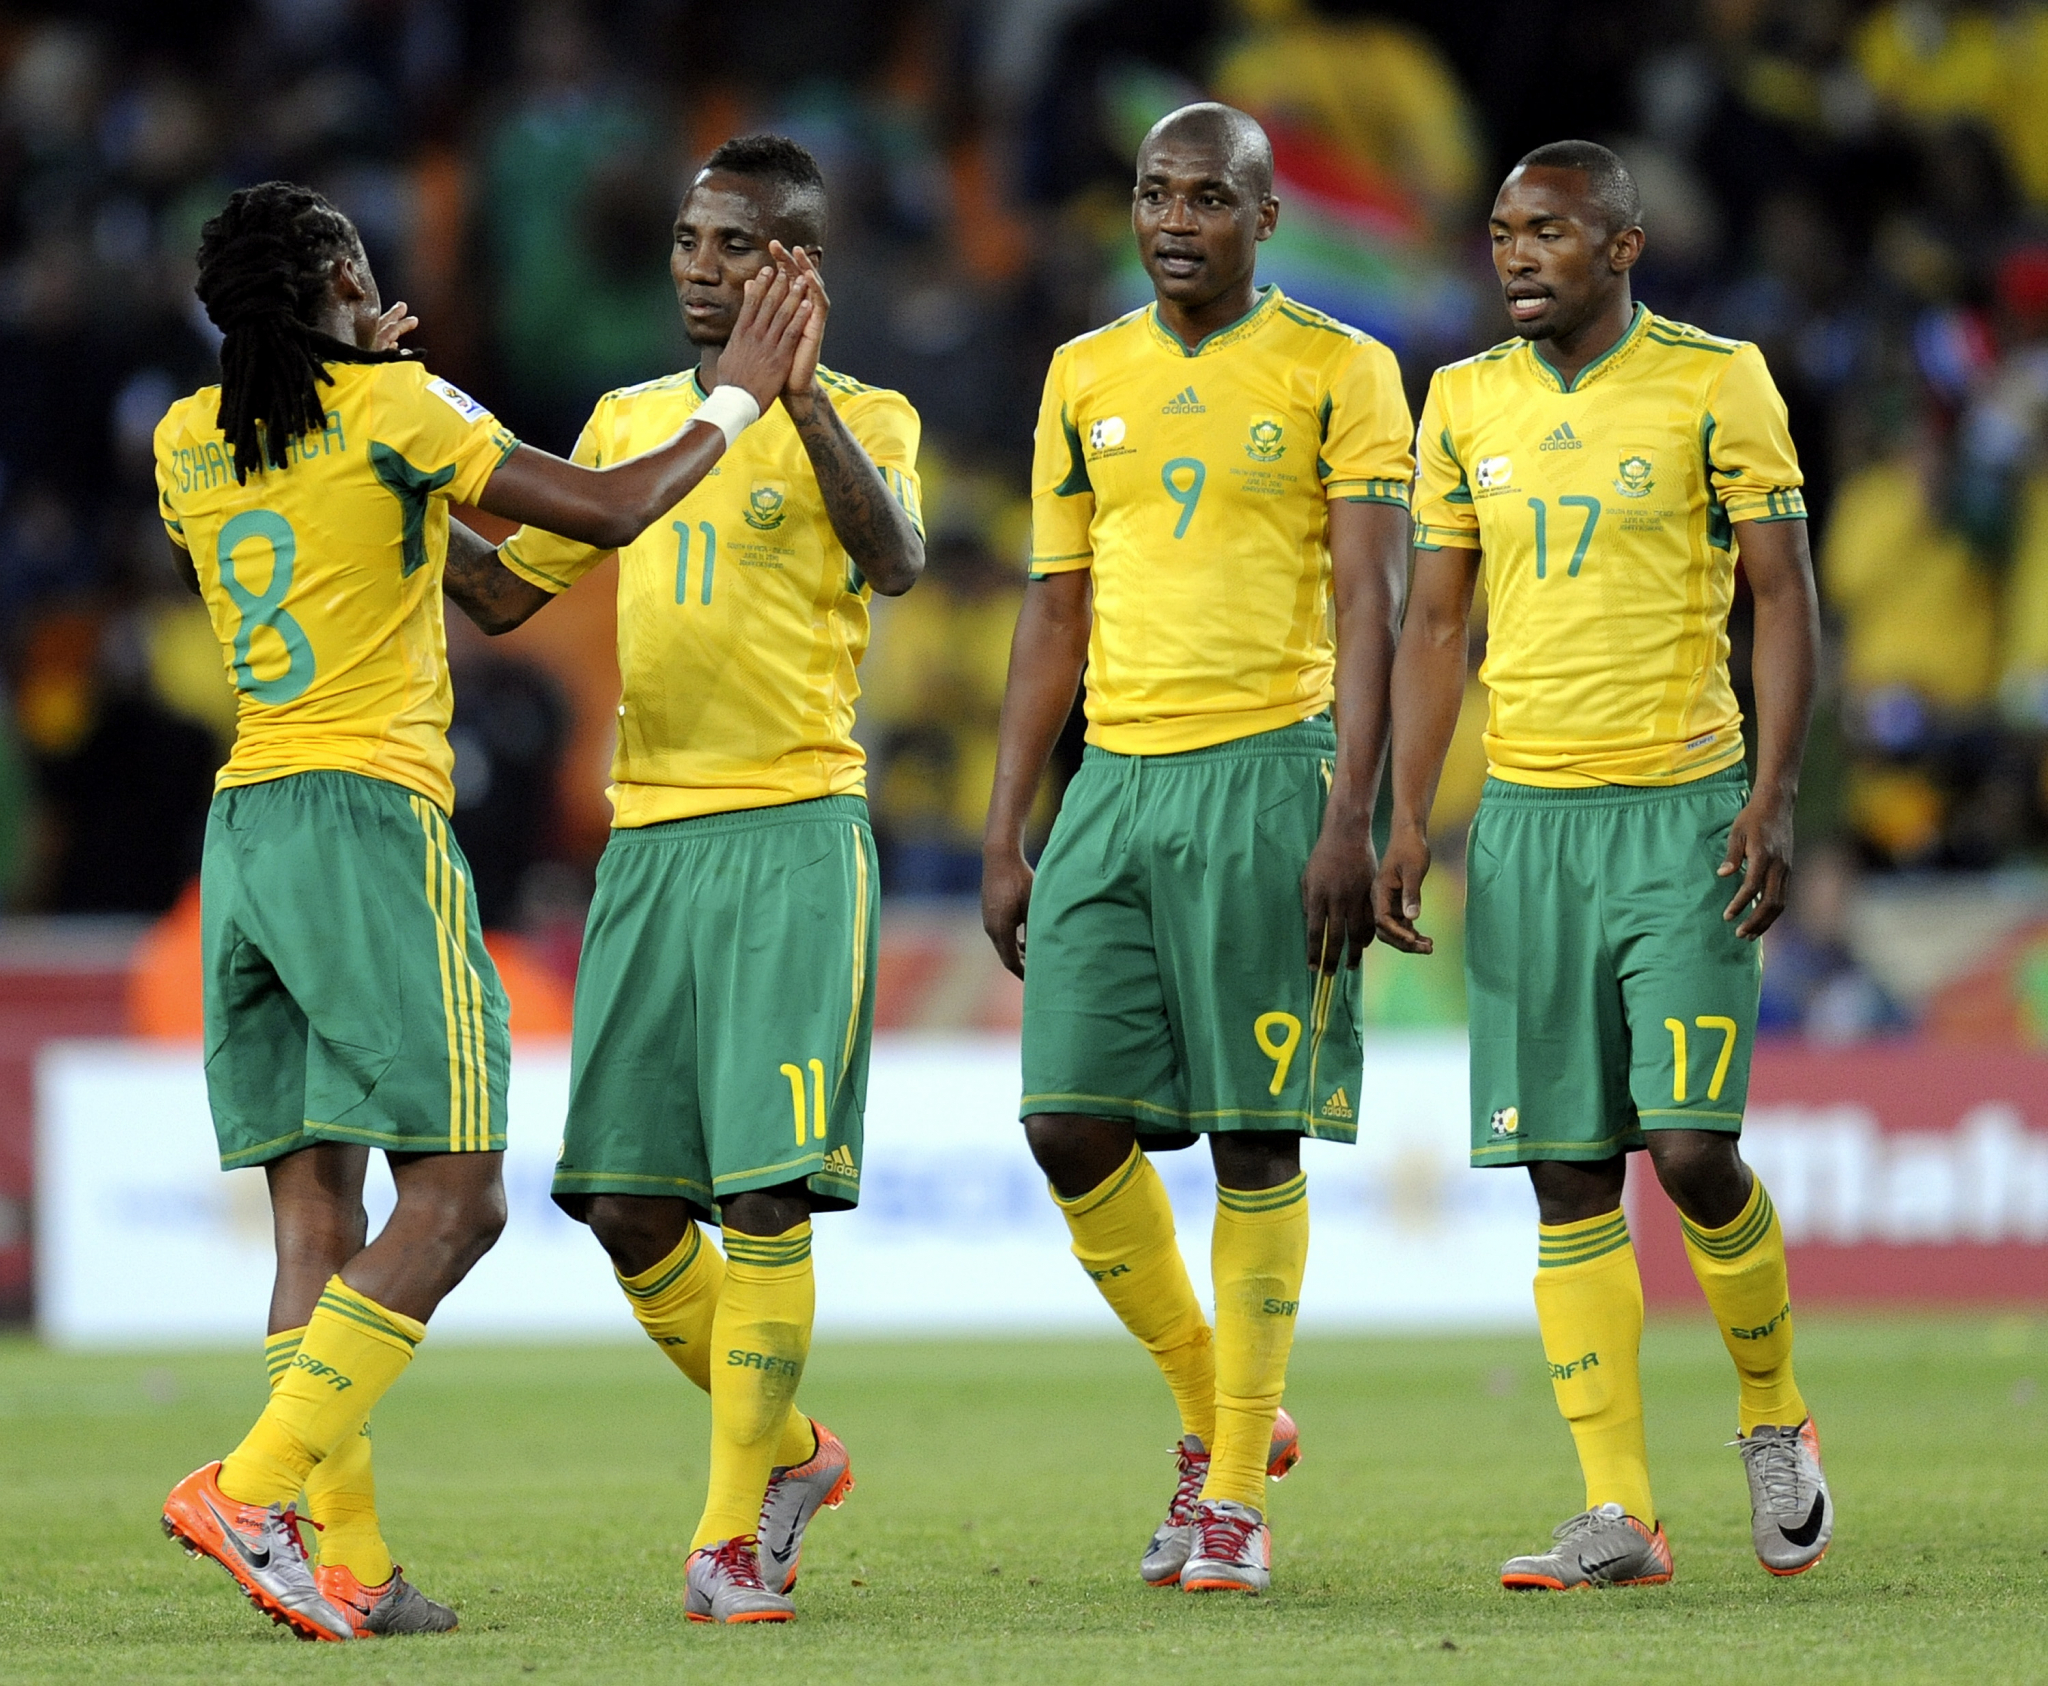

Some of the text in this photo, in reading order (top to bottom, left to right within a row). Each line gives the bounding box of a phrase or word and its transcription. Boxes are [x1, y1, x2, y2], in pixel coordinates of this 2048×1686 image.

[1161, 403, 1206, 415] adidas
[1539, 440, 1582, 451] adidas
[1161, 456, 1206, 540] 9
[1527, 495, 1601, 579] 17
[672, 520, 716, 606] 11
[217, 508, 316, 705] 8
[1253, 1011, 1302, 1096] 9
[1664, 1015, 1737, 1102] 17
[780, 1058, 826, 1147] 11
[1321, 1105, 1353, 1119] adidas
[822, 1160, 859, 1178] didas
[1263, 1298, 1299, 1317] SAF
[1730, 1302, 1790, 1340] SAFA
[291, 1352, 353, 1392] SAFA
[726, 1349, 798, 1377] SAFA
